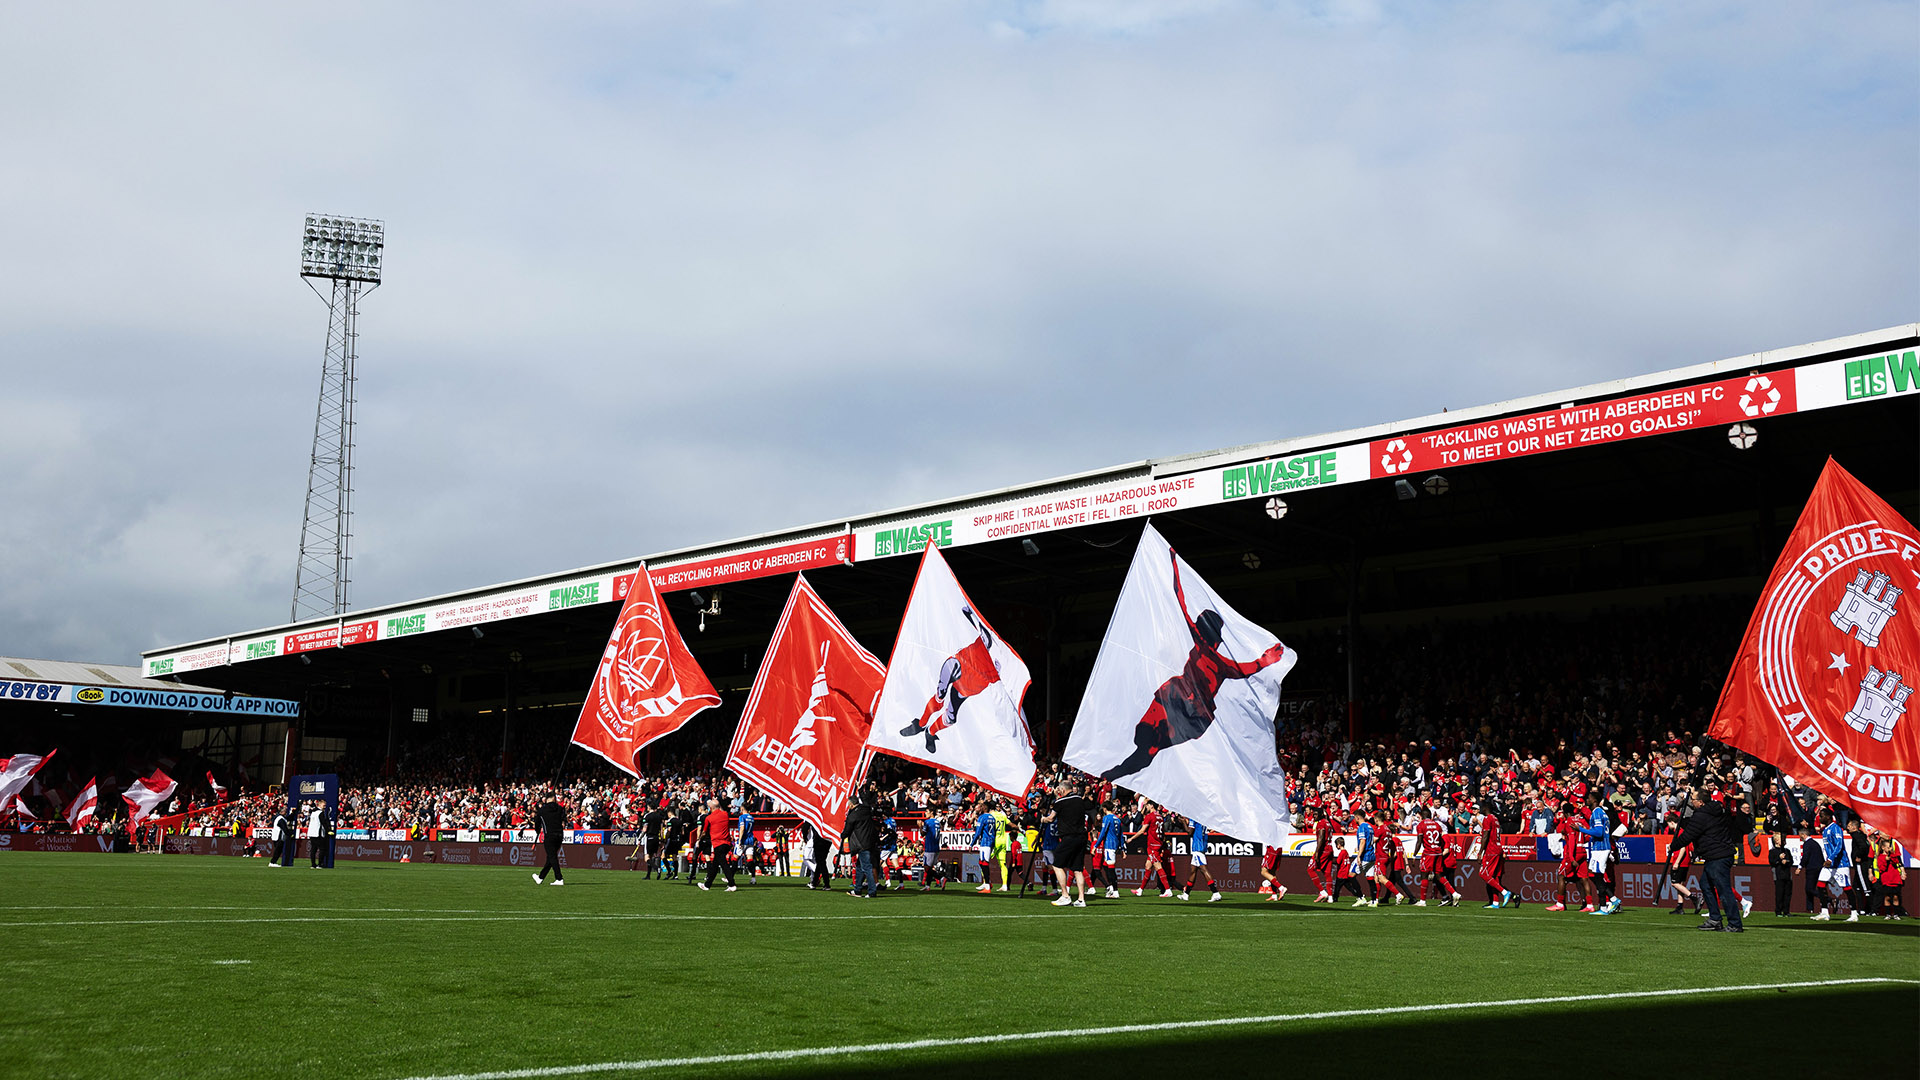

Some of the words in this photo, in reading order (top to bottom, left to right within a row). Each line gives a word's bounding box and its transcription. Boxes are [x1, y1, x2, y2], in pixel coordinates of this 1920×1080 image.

[1850, 372, 1886, 396] EIS
[1421, 425, 1499, 448] “TACKLING
[1503, 415, 1556, 436] WASTE
[1560, 407, 1600, 426] WITH
[1604, 391, 1695, 419] ABERDEEN
[1701, 386, 1724, 403] FC
[1441, 450, 1460, 463] TO
[1463, 443, 1503, 461] MEET
[1507, 436, 1540, 453] OUR
[1545, 431, 1575, 448] NET
[1580, 423, 1624, 442] ZERO
[1629, 409, 1702, 434] GOALS!”
[1224, 479, 1246, 498] EIS
[1247, 451, 1337, 495] WASTE
[1270, 475, 1320, 492] SERVICES
[973, 514, 993, 527] SKIP
[994, 510, 1015, 523] HIRE
[1022, 504, 1053, 517] TRADE
[1055, 497, 1087, 512] WASTE
[1095, 485, 1157, 505] HAZARDOUS
[1159, 478, 1195, 494] WASTE
[987, 519, 1050, 538] CONFIDENTIAL
[1053, 512, 1086, 527] WASTE
[1092, 509, 1110, 520] FEL
[1119, 504, 1139, 516] REL
[1148, 496, 1178, 511] RORO
[877, 541, 891, 554] EIS
[892, 520, 953, 554] WASTE
[908, 539, 941, 551] SERVS
[668, 567, 712, 584] RECYCLING
[713, 561, 751, 577] PARTNER
[752, 558, 764, 571] OF
[765, 550, 812, 568] ABERDEEN
[814, 547, 826, 560] FC
[1803, 528, 1887, 579] PRIDE
[435, 610, 446, 619] SKIP
[446, 608, 456, 617] HIRE
[459, 606, 473, 614] TRADE
[474, 603, 489, 611] WASTE
[492, 598, 521, 608] HAZARDOUS
[521, 594, 538, 603] WASTE
[561, 582, 599, 608] WASTE
[396, 614, 426, 636] WASTE
[441, 616, 472, 627] CONFIDENTIAL
[472, 613, 488, 622] WASTE
[515, 606, 529, 614] RORO
[253, 640, 276, 658] WASTE
[155, 658, 174, 674] WASTE
[0, 681, 62, 701] 78787
[80, 691, 102, 699] uBook
[110, 690, 198, 708] DOWNLOAD
[201, 696, 232, 711] OUR
[235, 698, 262, 712] APP
[264, 701, 300, 715] NOW
[996, 820, 1005, 832] 27
[1425, 830, 1440, 844] 32
[575, 834, 584, 844] sky
[584, 835, 601, 844] sports
[1171, 837, 1188, 855] la
[1624, 880, 1653, 898] EIS
[1656, 873, 1753, 902] WAE
